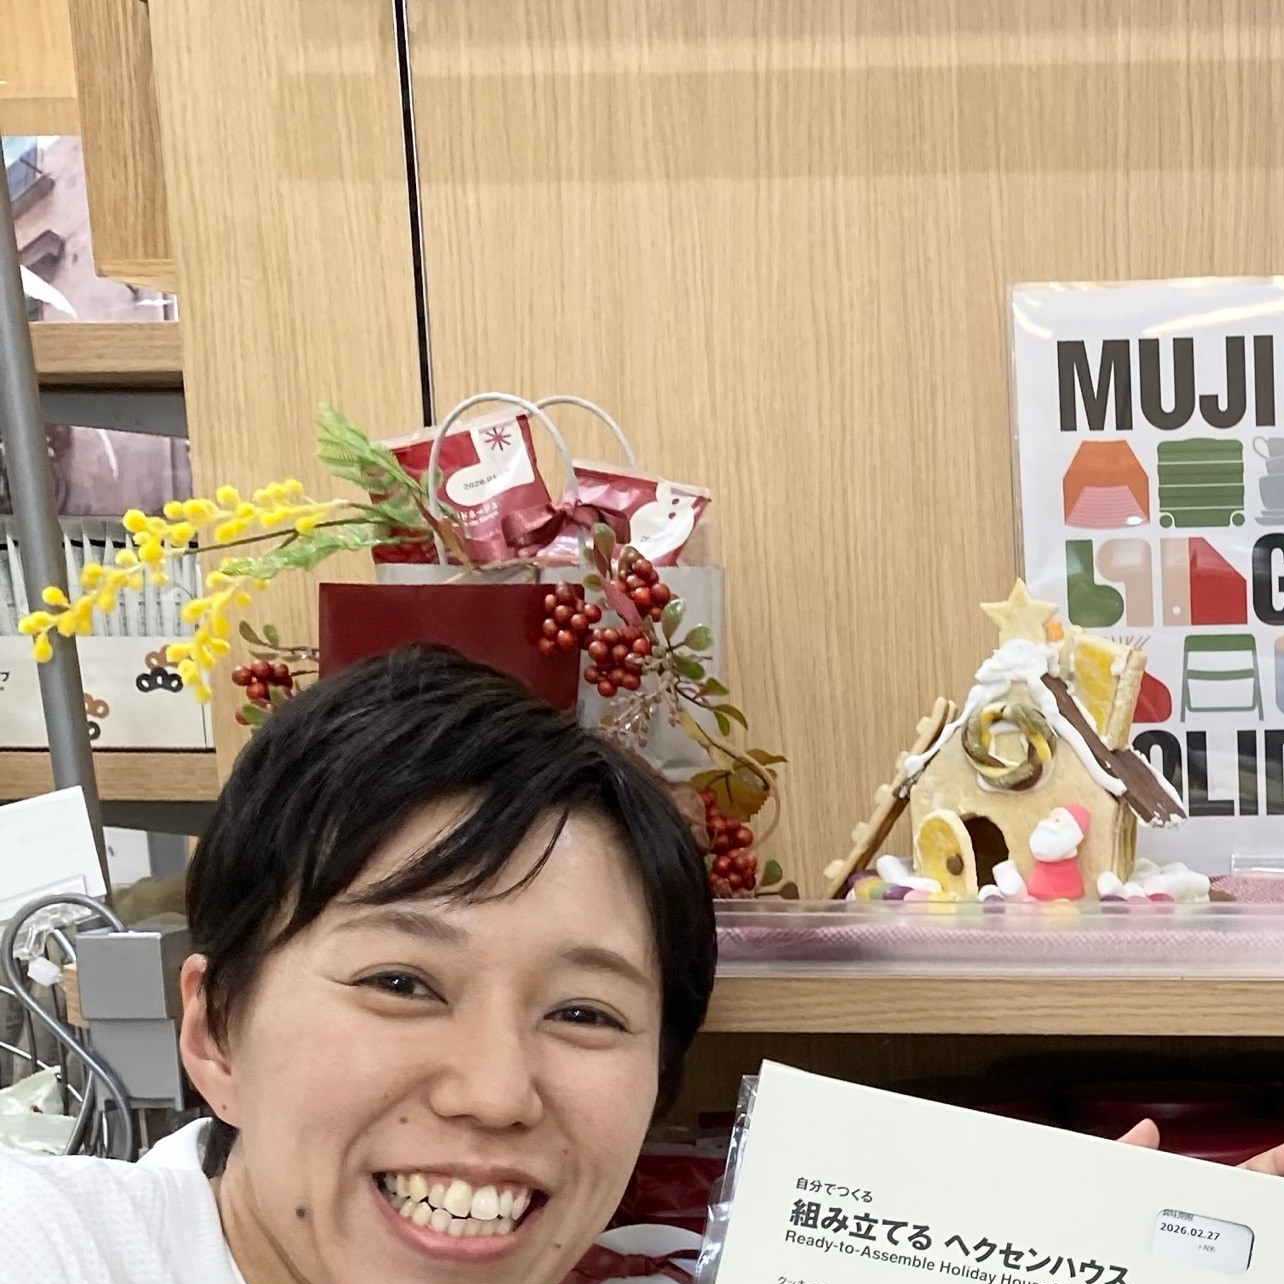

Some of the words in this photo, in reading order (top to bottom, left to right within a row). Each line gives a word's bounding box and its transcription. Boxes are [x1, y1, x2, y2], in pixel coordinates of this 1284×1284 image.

[1057, 335, 1276, 431] MUJI
[796, 1177, 873, 1203] 自分でつくる
[789, 1198, 933, 1251] 組み立てる
[1160, 1222, 1221, 1241] 2026.02.27
[785, 1229, 935, 1271] Ready-to-Assemble
